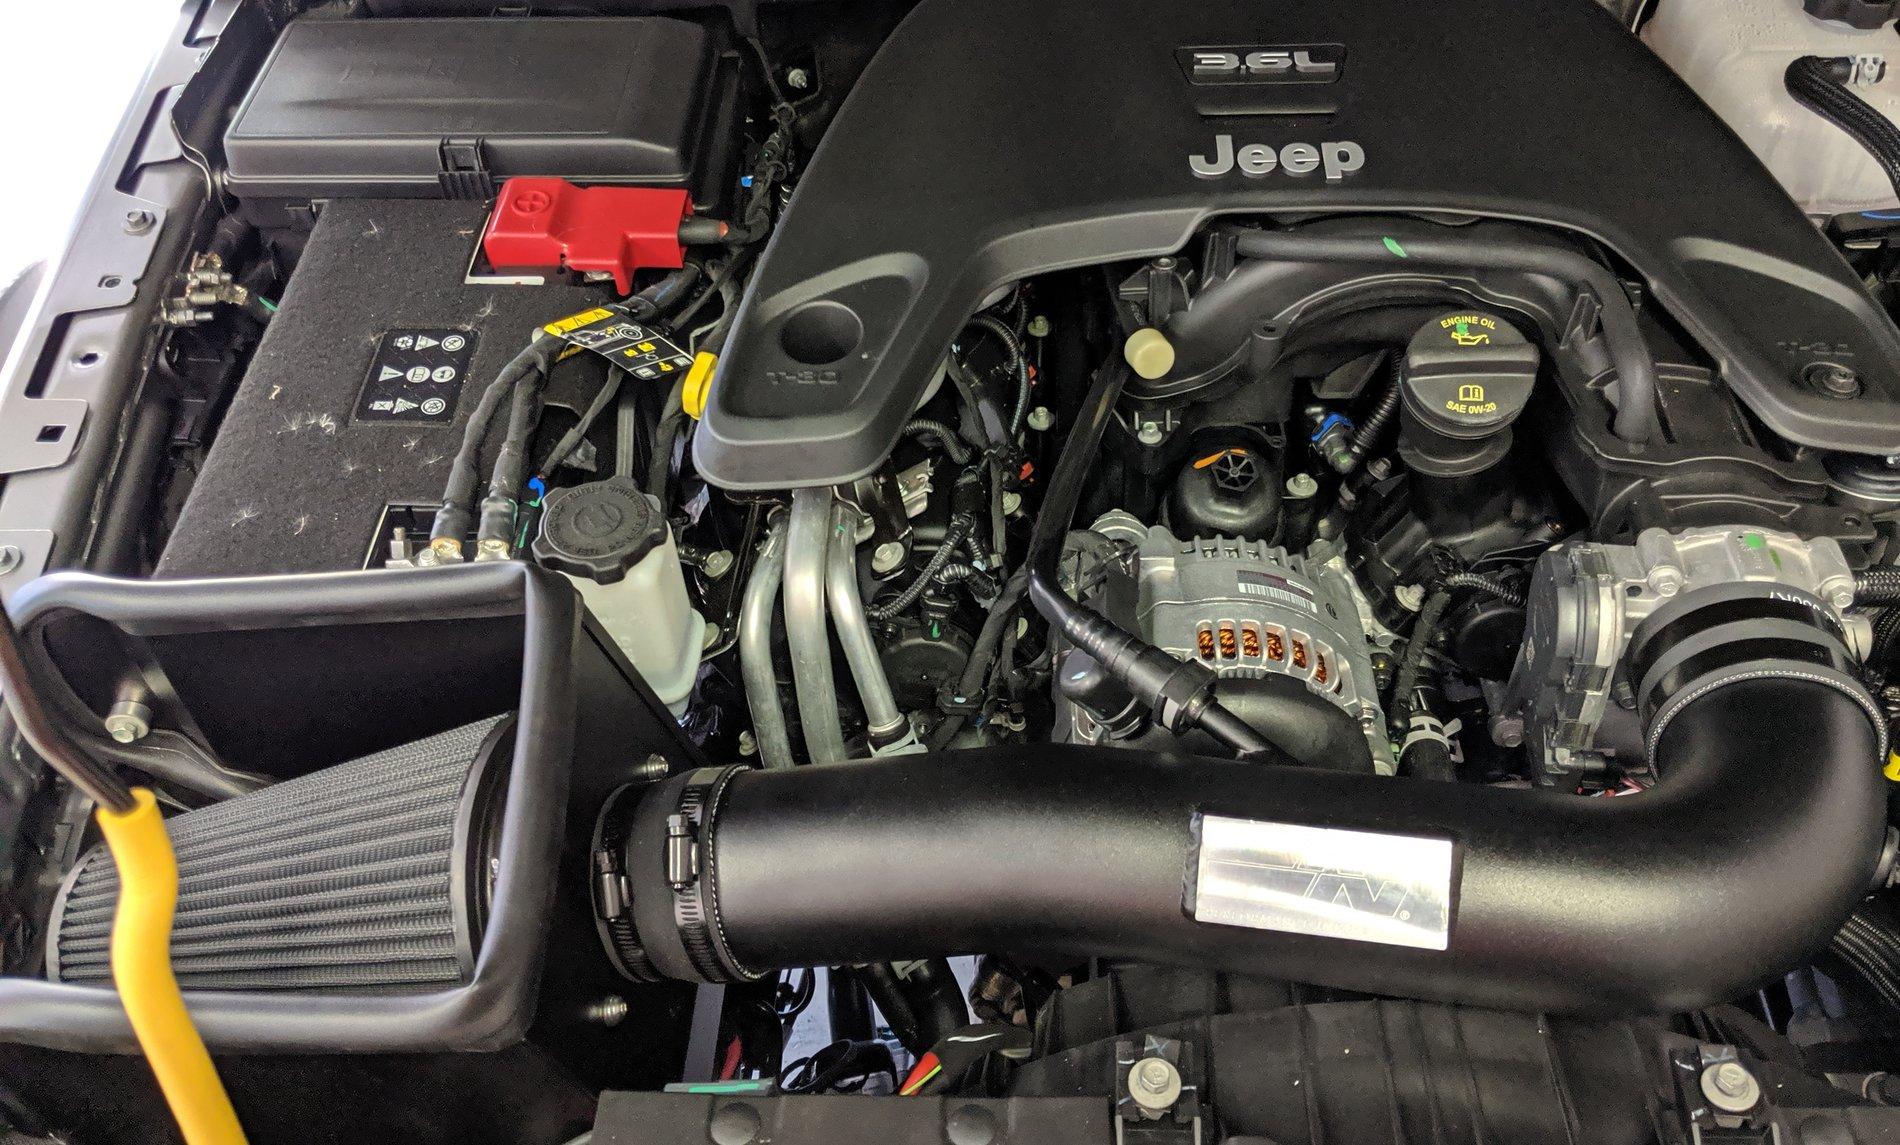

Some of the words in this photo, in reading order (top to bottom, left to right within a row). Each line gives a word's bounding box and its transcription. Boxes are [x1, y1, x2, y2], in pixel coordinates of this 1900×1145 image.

[1193, 51, 1336, 73] 3.6L
[1188, 134, 1366, 183] Jeep
[1440, 315, 1479, 329] ENGINE
[1480, 317, 1496, 330] OIL
[1445, 400, 1467, 414] SAE
